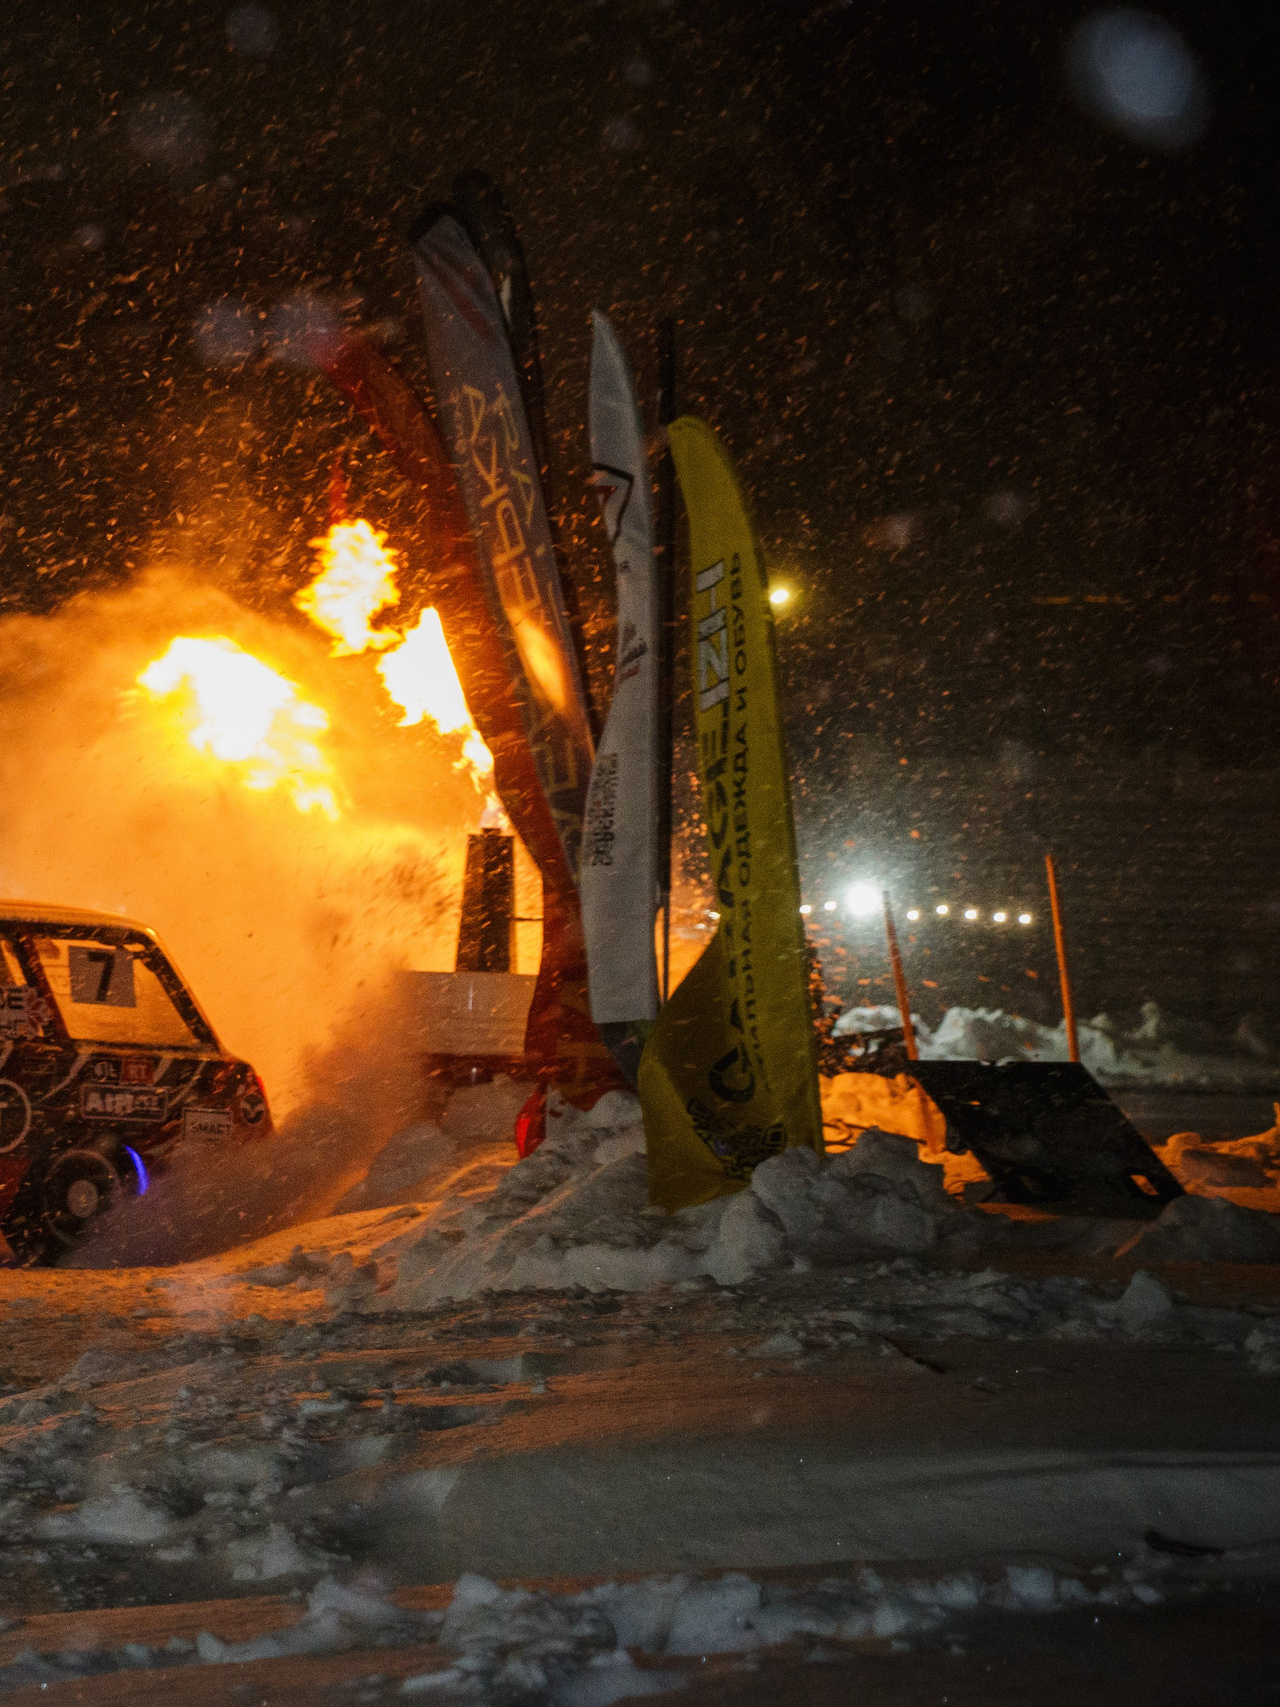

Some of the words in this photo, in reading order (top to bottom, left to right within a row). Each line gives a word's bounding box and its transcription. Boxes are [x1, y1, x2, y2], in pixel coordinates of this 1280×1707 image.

[729, 552, 748, 677] ОБУВЬ
[735, 686, 749, 713] И
[731, 722, 752, 889] ОДЕЖДА
[87, 951, 115, 1002] 7
